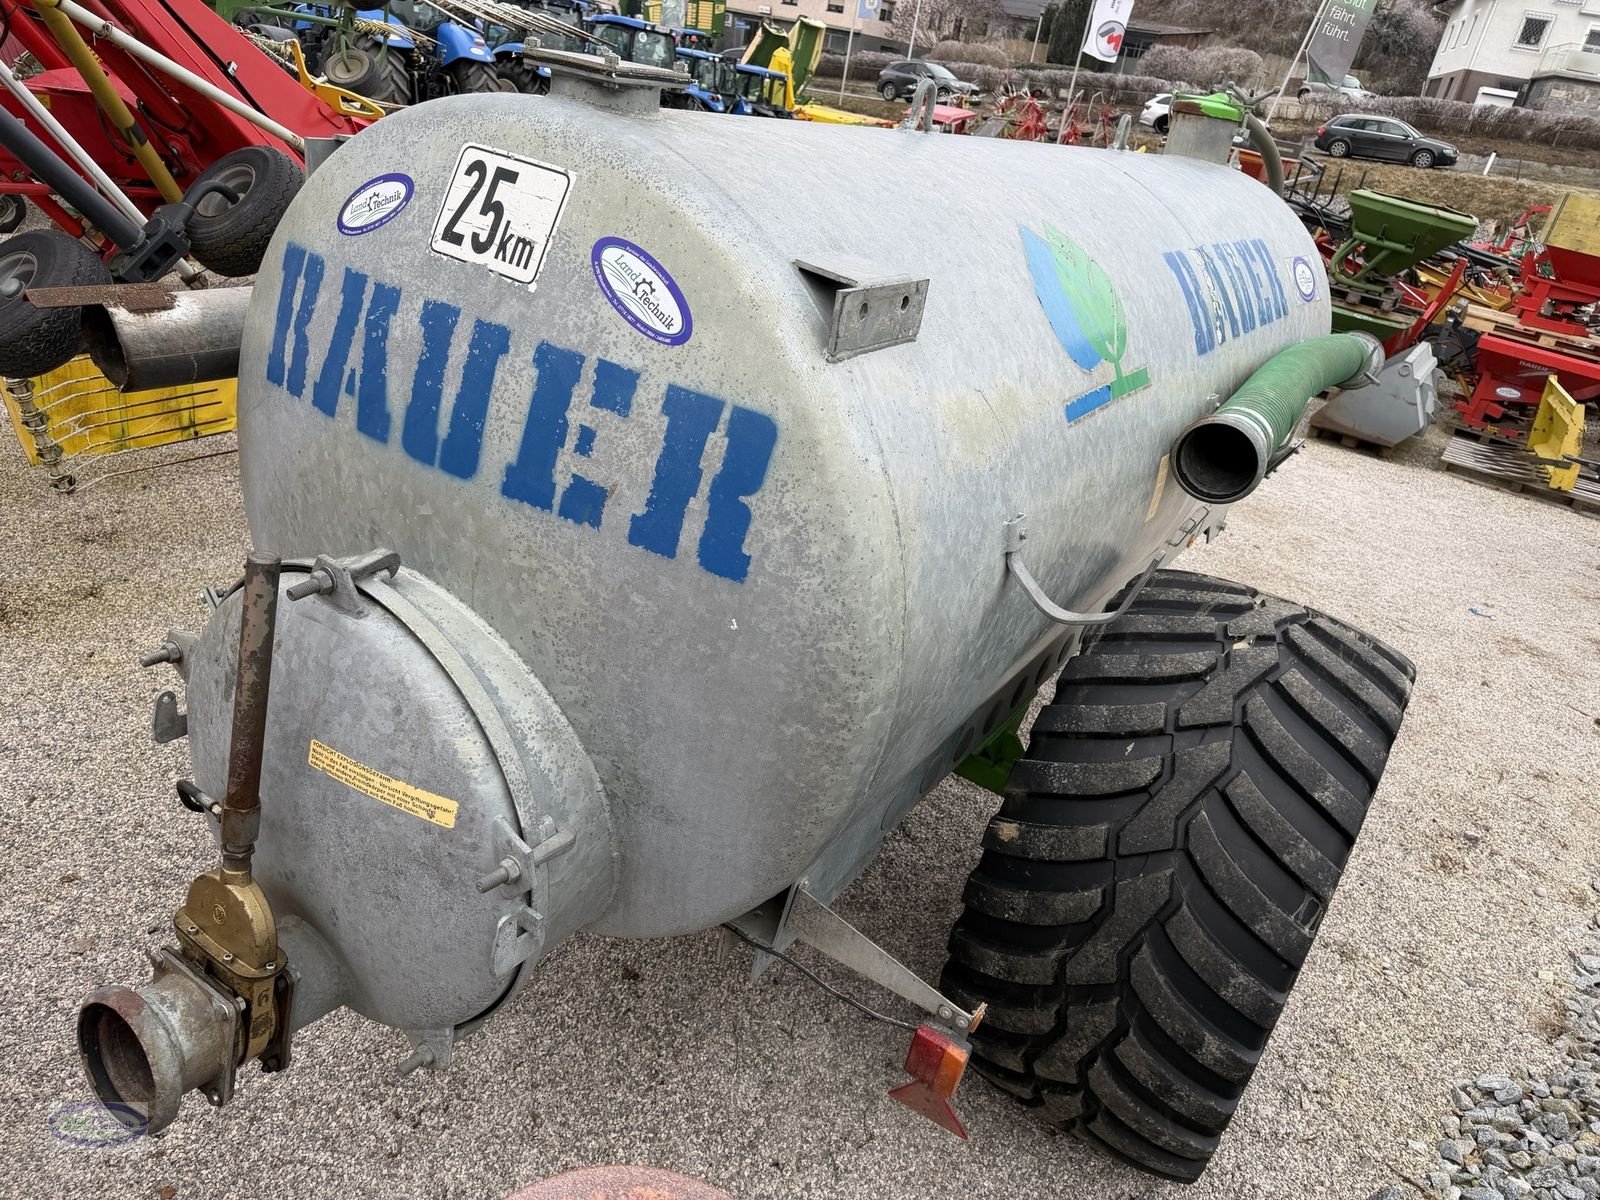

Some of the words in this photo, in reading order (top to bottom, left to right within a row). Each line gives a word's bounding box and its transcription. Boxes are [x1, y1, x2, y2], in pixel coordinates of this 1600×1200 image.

[1322, 22, 1349, 42] führt.
[1330, 5, 1355, 26] fährt,
[350, 197, 368, 215] Land
[372, 190, 401, 210] Technik
[441, 159, 520, 255] 25
[494, 220, 535, 270] km
[614, 254, 642, 282] Land
[638, 289, 674, 330] Technik
[1162, 239, 1289, 357] BAUER
[266, 241, 778, 585] BAUER
[312, 741, 336, 756] VORSICHT
[325, 761, 335, 769] und
[335, 766, 352, 778] andere
[396, 795, 410, 804] einer
[329, 757, 339, 765] das
[378, 781, 401, 794] Vorsicht
[379, 794, 392, 803] dem
